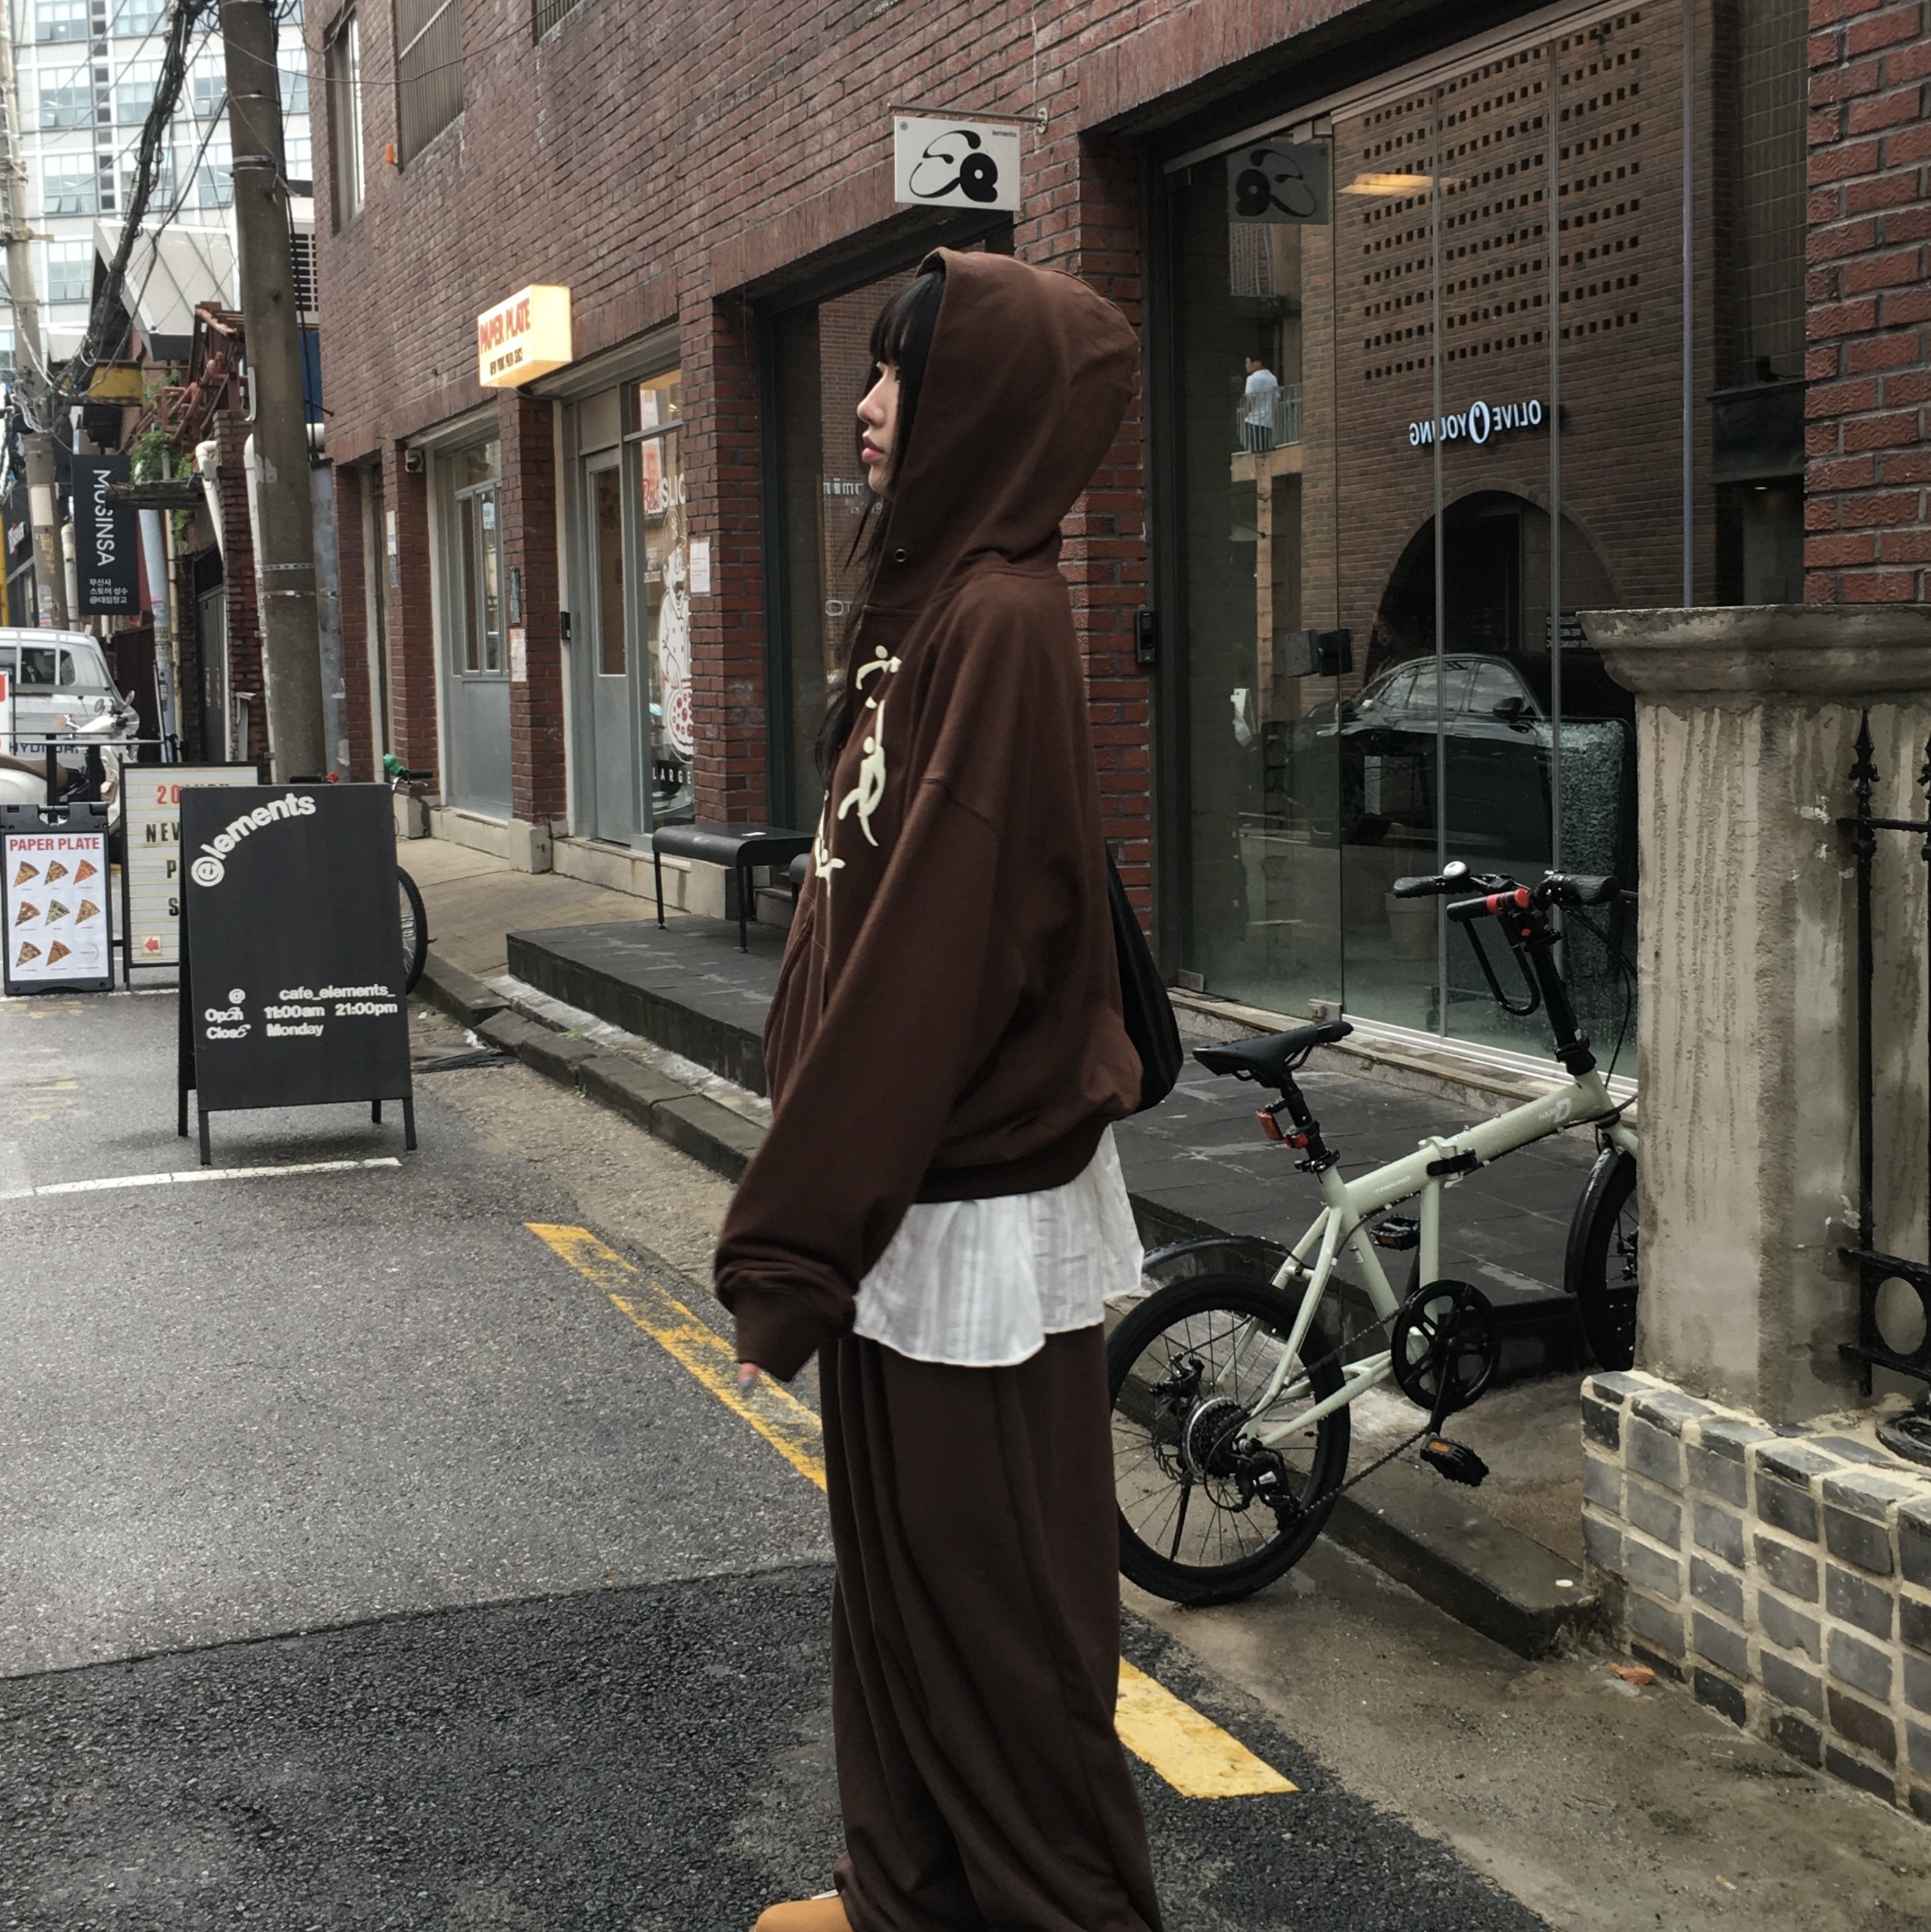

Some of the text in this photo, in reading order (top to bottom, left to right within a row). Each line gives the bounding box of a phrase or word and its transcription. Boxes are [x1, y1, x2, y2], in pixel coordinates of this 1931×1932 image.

[479, 297, 531, 355] PAPER PLATE
[661, 473, 686, 508] SLIC
[92, 470, 115, 566] MUSINSA
[89, 578, 111, 587] 무신사
[652, 767, 691, 785] LARGE
[10, 837, 100, 851] PAPER PLATE
[264, 1005, 325, 1018] 11:00am
[335, 1002, 398, 1016] 21:00pm
[266, 1023, 324, 1037] Monday
